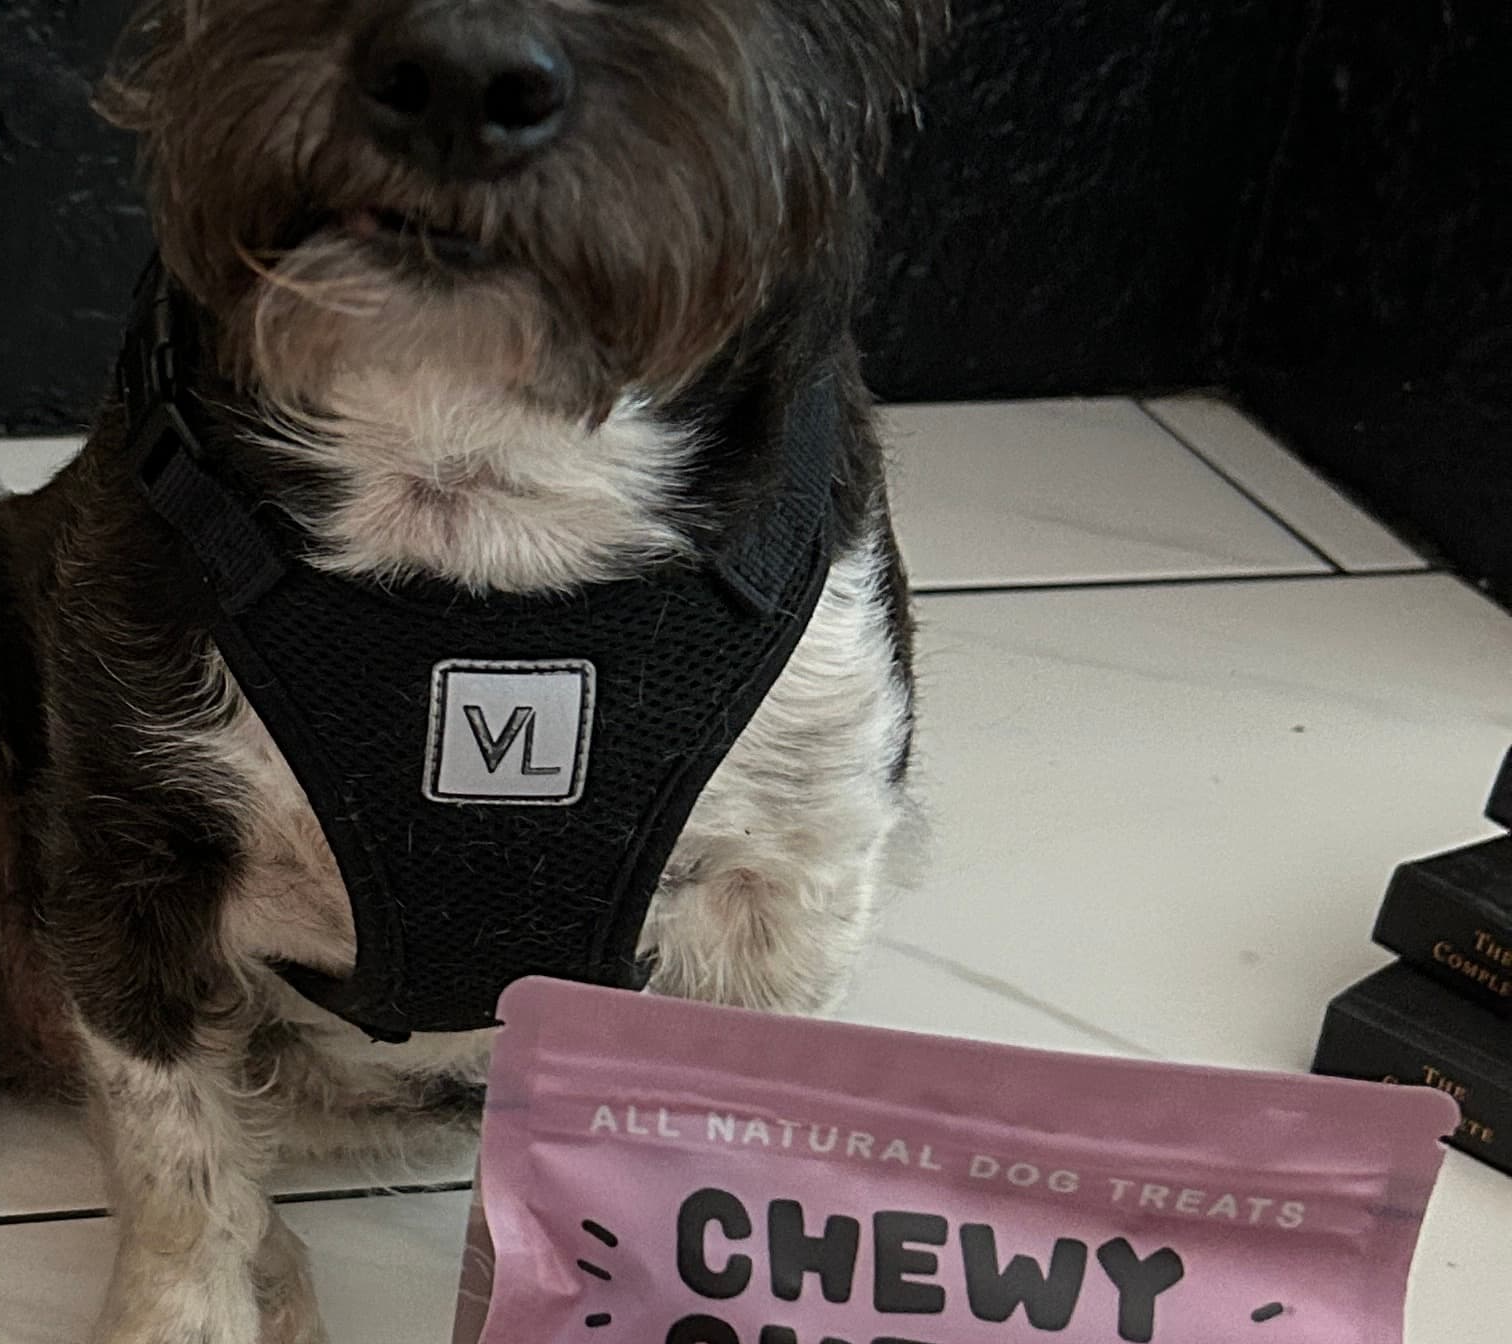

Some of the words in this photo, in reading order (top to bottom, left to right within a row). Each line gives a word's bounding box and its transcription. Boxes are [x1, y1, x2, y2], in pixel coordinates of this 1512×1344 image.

[463, 705, 561, 775] VL
[589, 1104, 681, 1139] ALL
[707, 1113, 942, 1172] NATURAL
[968, 1155, 1080, 1196] DOG
[1108, 1179, 1307, 1230] TREATS
[676, 1187, 1184, 1344] CHEWY
